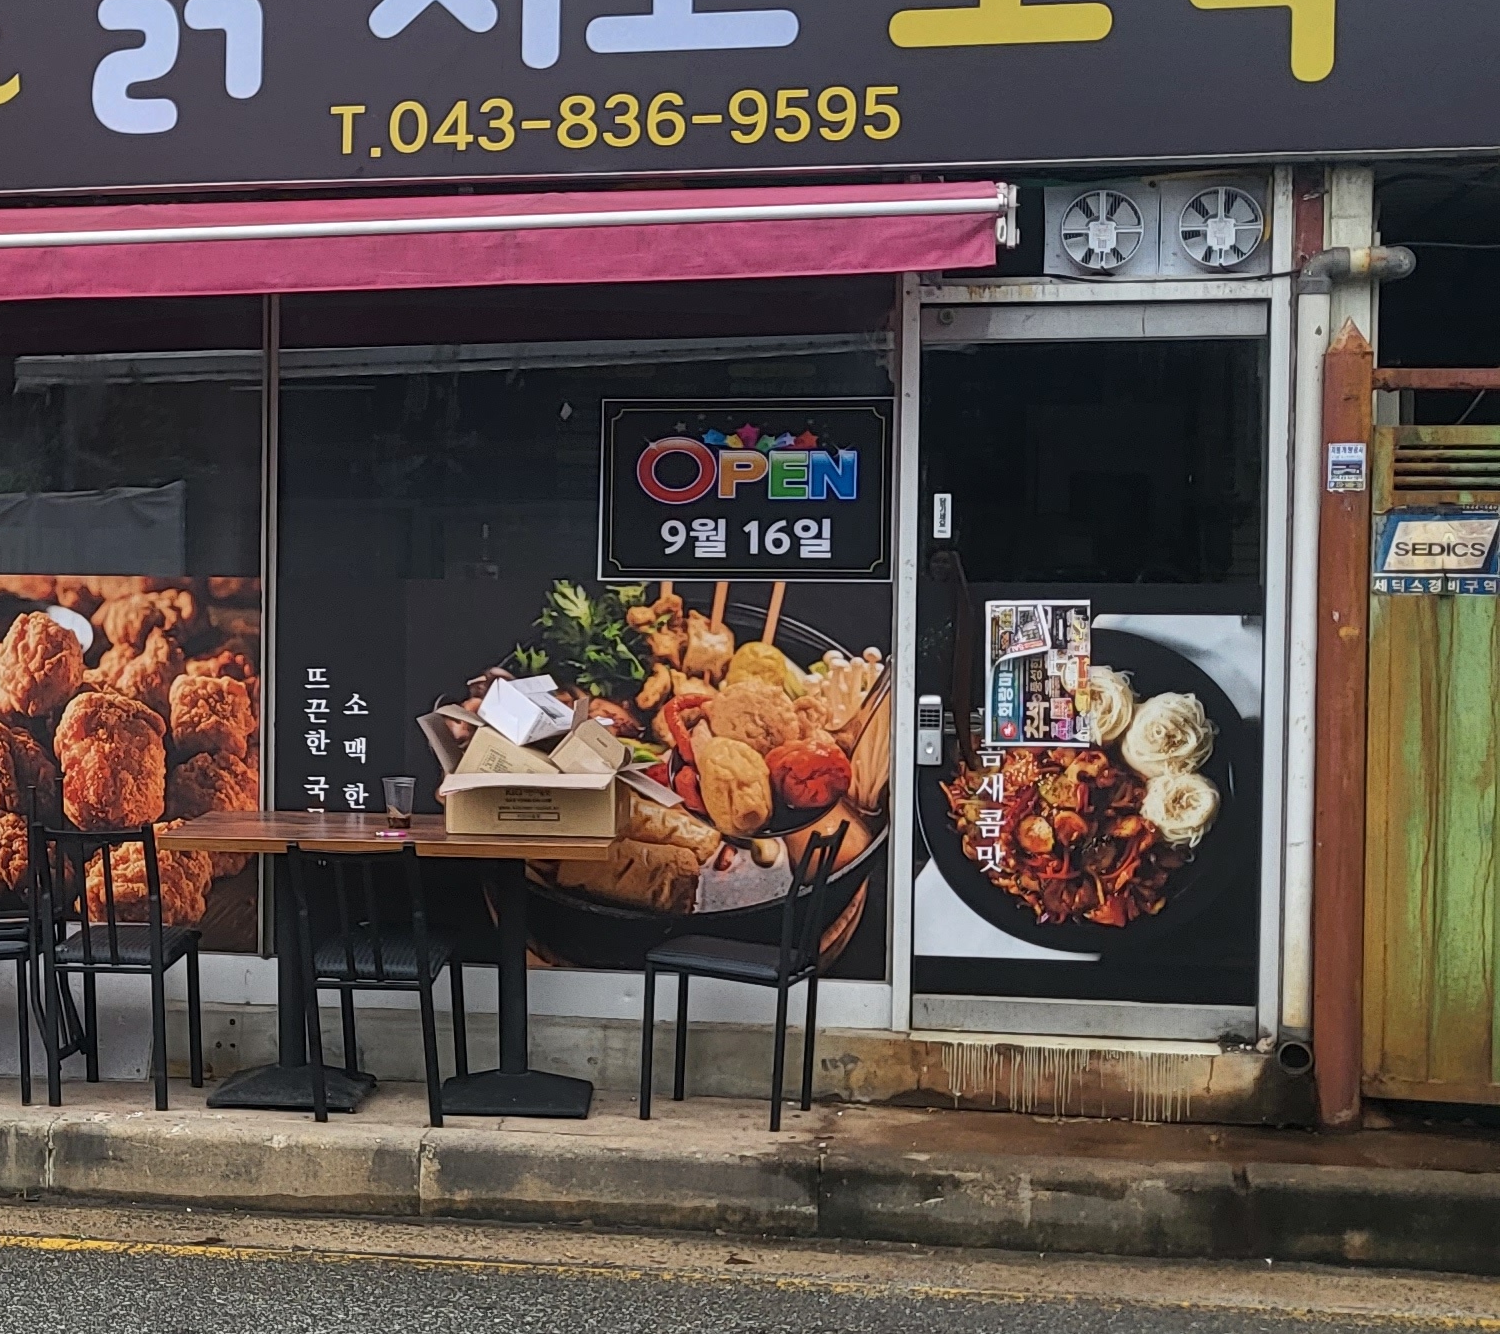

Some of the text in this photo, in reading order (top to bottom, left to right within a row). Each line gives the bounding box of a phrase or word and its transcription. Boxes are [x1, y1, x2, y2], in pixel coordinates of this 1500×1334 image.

[330, 85, 902, 159] T.043-836-9595
[636, 436, 858, 505] OPEN
[660, 518, 832, 559] 9월 16일
[1393, 541, 1486, 558] SEDICS
[304, 668, 331, 755] 뜨끈한
